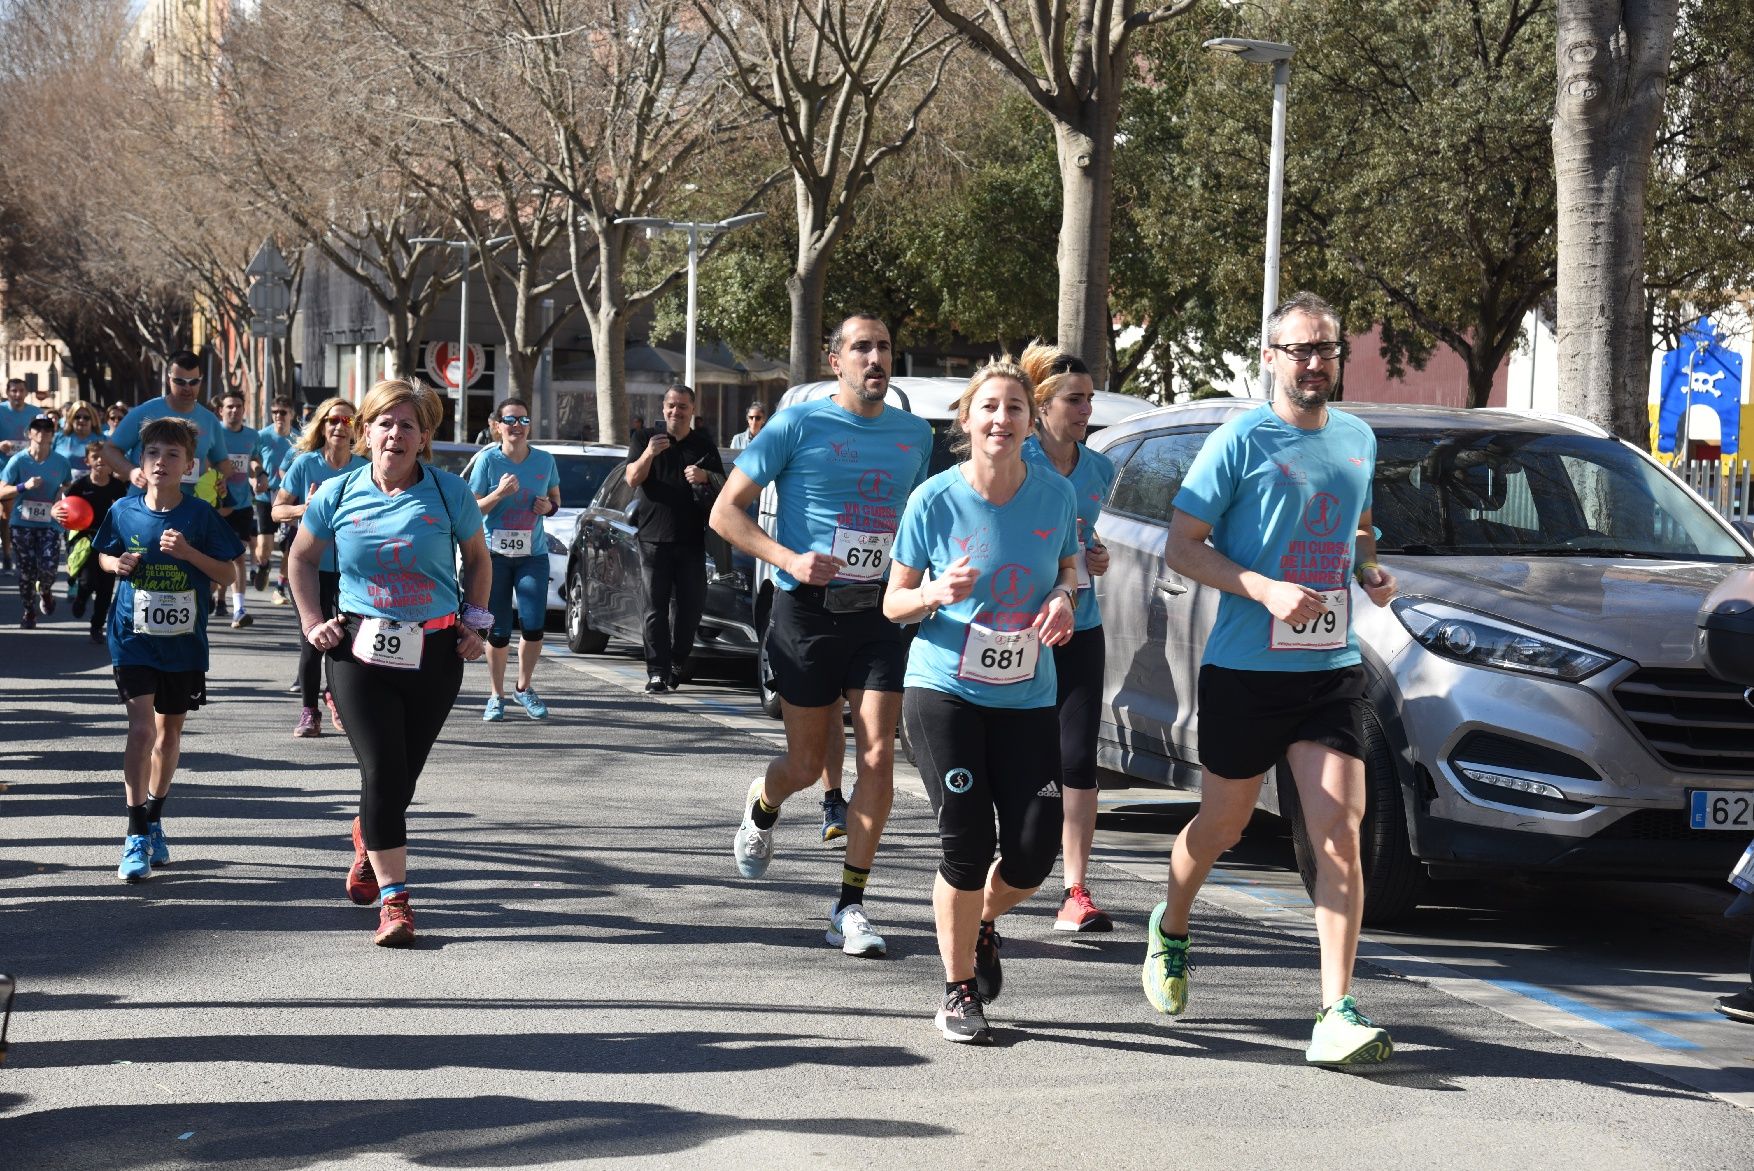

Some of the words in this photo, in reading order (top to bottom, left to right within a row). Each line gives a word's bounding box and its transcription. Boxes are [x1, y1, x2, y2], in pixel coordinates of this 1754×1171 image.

[28, 507, 45, 517] 184
[500, 539, 524, 550] 549
[846, 547, 883, 569] 678
[1280, 555, 1298, 569] DE
[1300, 556, 1318, 569] LA
[373, 592, 433, 609] MANRESA
[141, 607, 190, 626] 1063
[373, 633, 401, 655] 39
[981, 647, 1025, 670] 681
[1036, 789, 1062, 798] adidas
[1695, 813, 1703, 822] E
[1712, 797, 1754, 826] 62
